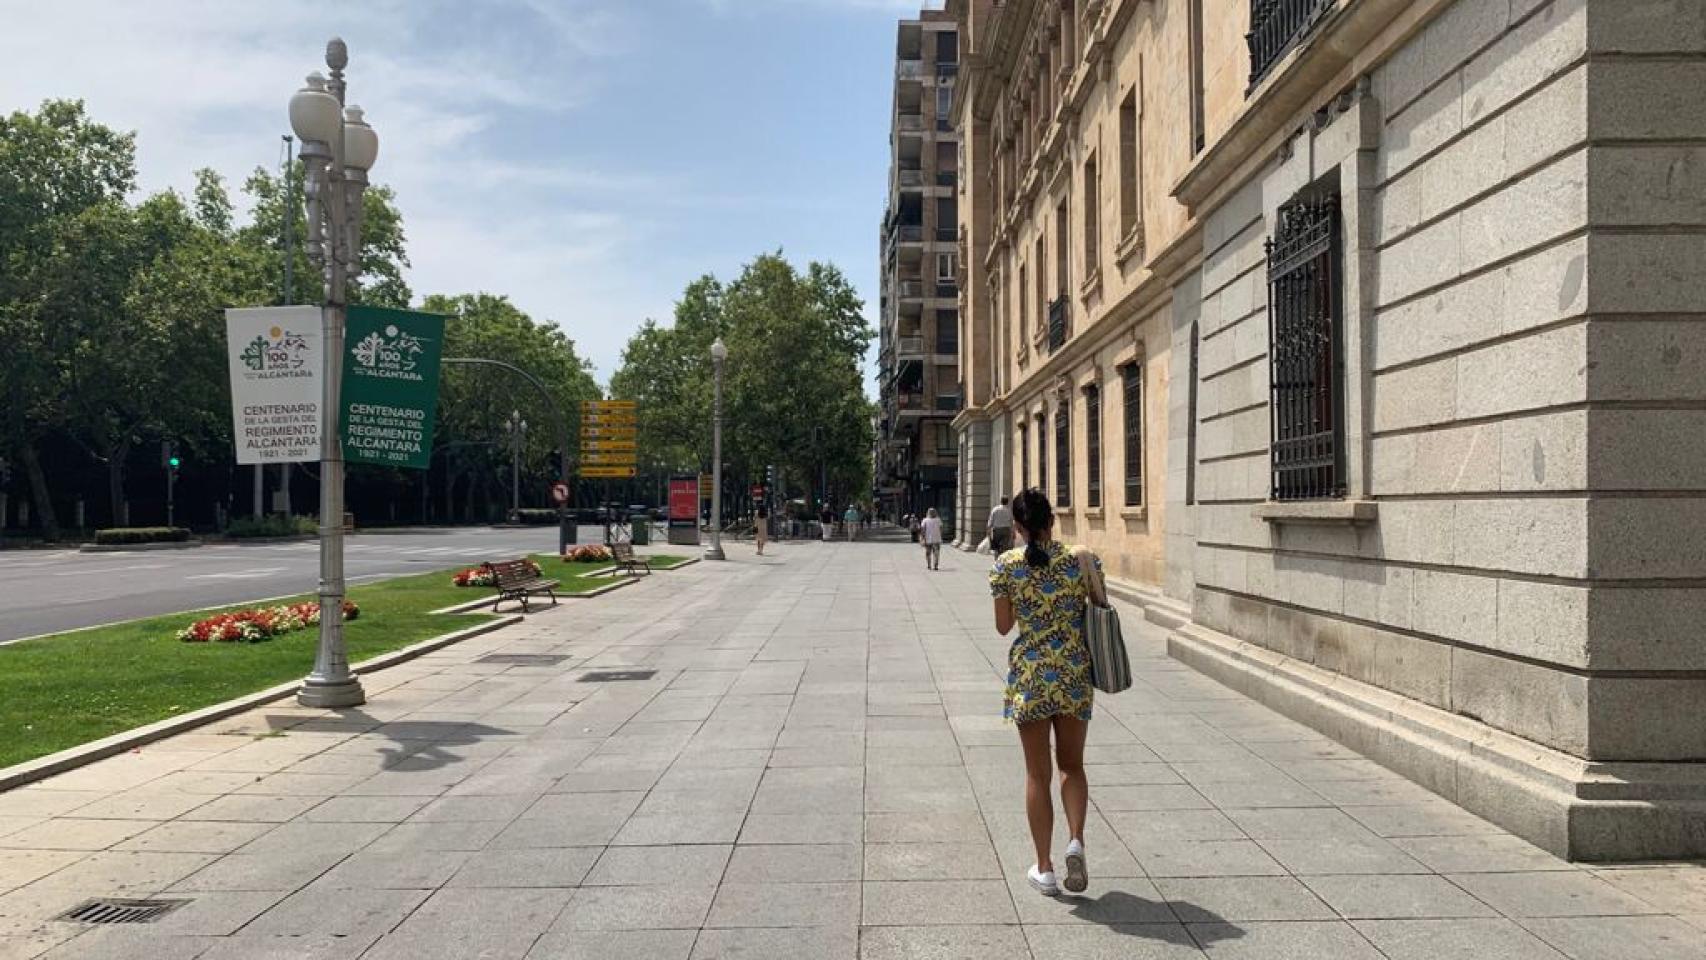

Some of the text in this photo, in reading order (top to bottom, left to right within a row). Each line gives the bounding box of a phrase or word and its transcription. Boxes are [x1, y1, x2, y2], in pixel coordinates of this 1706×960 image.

[266, 352, 288, 362] 100
[379, 351, 401, 362] 100
[243, 403, 317, 416] CENTENARIO
[350, 403, 425, 420] CENTENARIO
[258, 416, 269, 424] LA
[350, 414, 361, 424] DE
[363, 416, 376, 425] LA
[377, 416, 405, 427] GESTA
[246, 424, 317, 437] REGIMIENTO
[348, 424, 423, 441] REGIMIENTO
[259, 449, 279, 458] 1921
[287, 448, 308, 457] 2021
[359, 449, 380, 458] 1921
[387, 451, 409, 461] 2021
